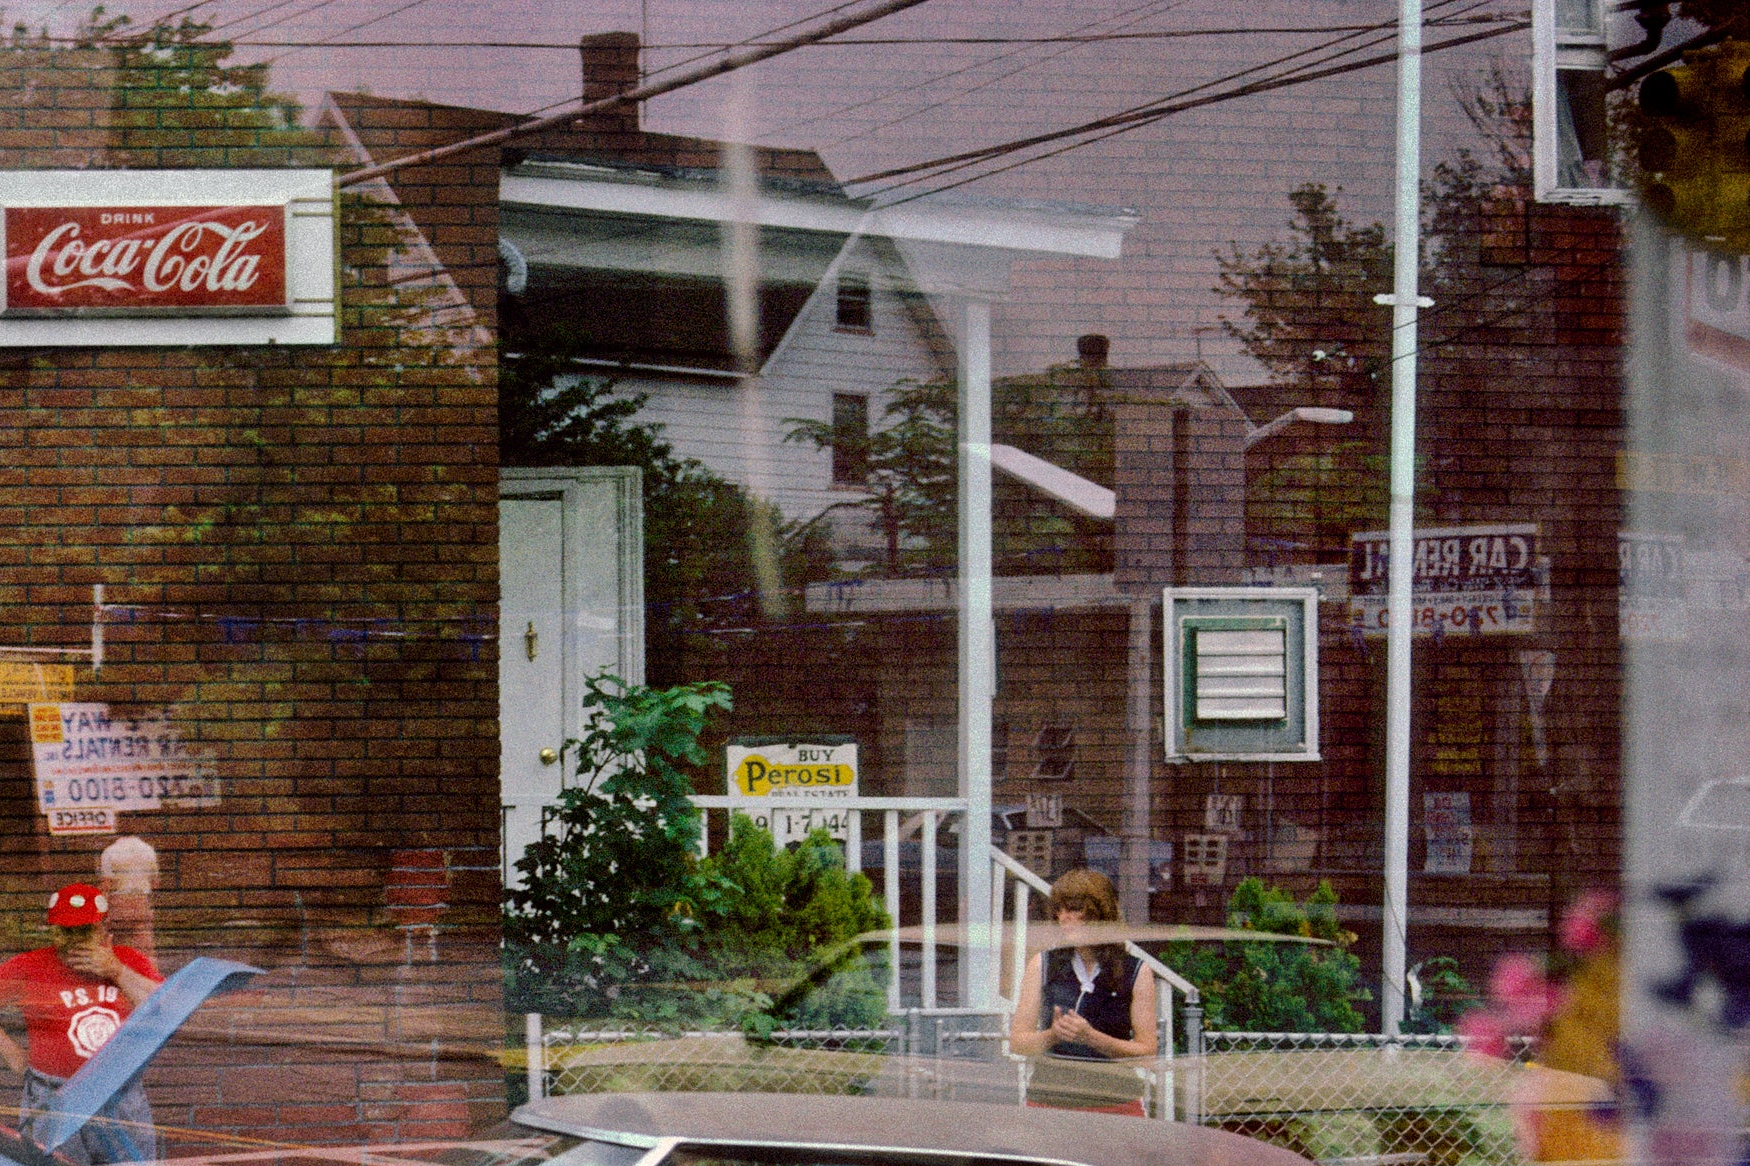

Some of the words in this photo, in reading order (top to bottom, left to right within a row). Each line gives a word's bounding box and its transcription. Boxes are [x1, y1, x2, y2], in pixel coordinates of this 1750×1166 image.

[100, 212, 155, 225] DRINK
[26, 219, 270, 295] Coca-Cola
[798, 749, 835, 763] BUY
[745, 761, 842, 793] Perosi
